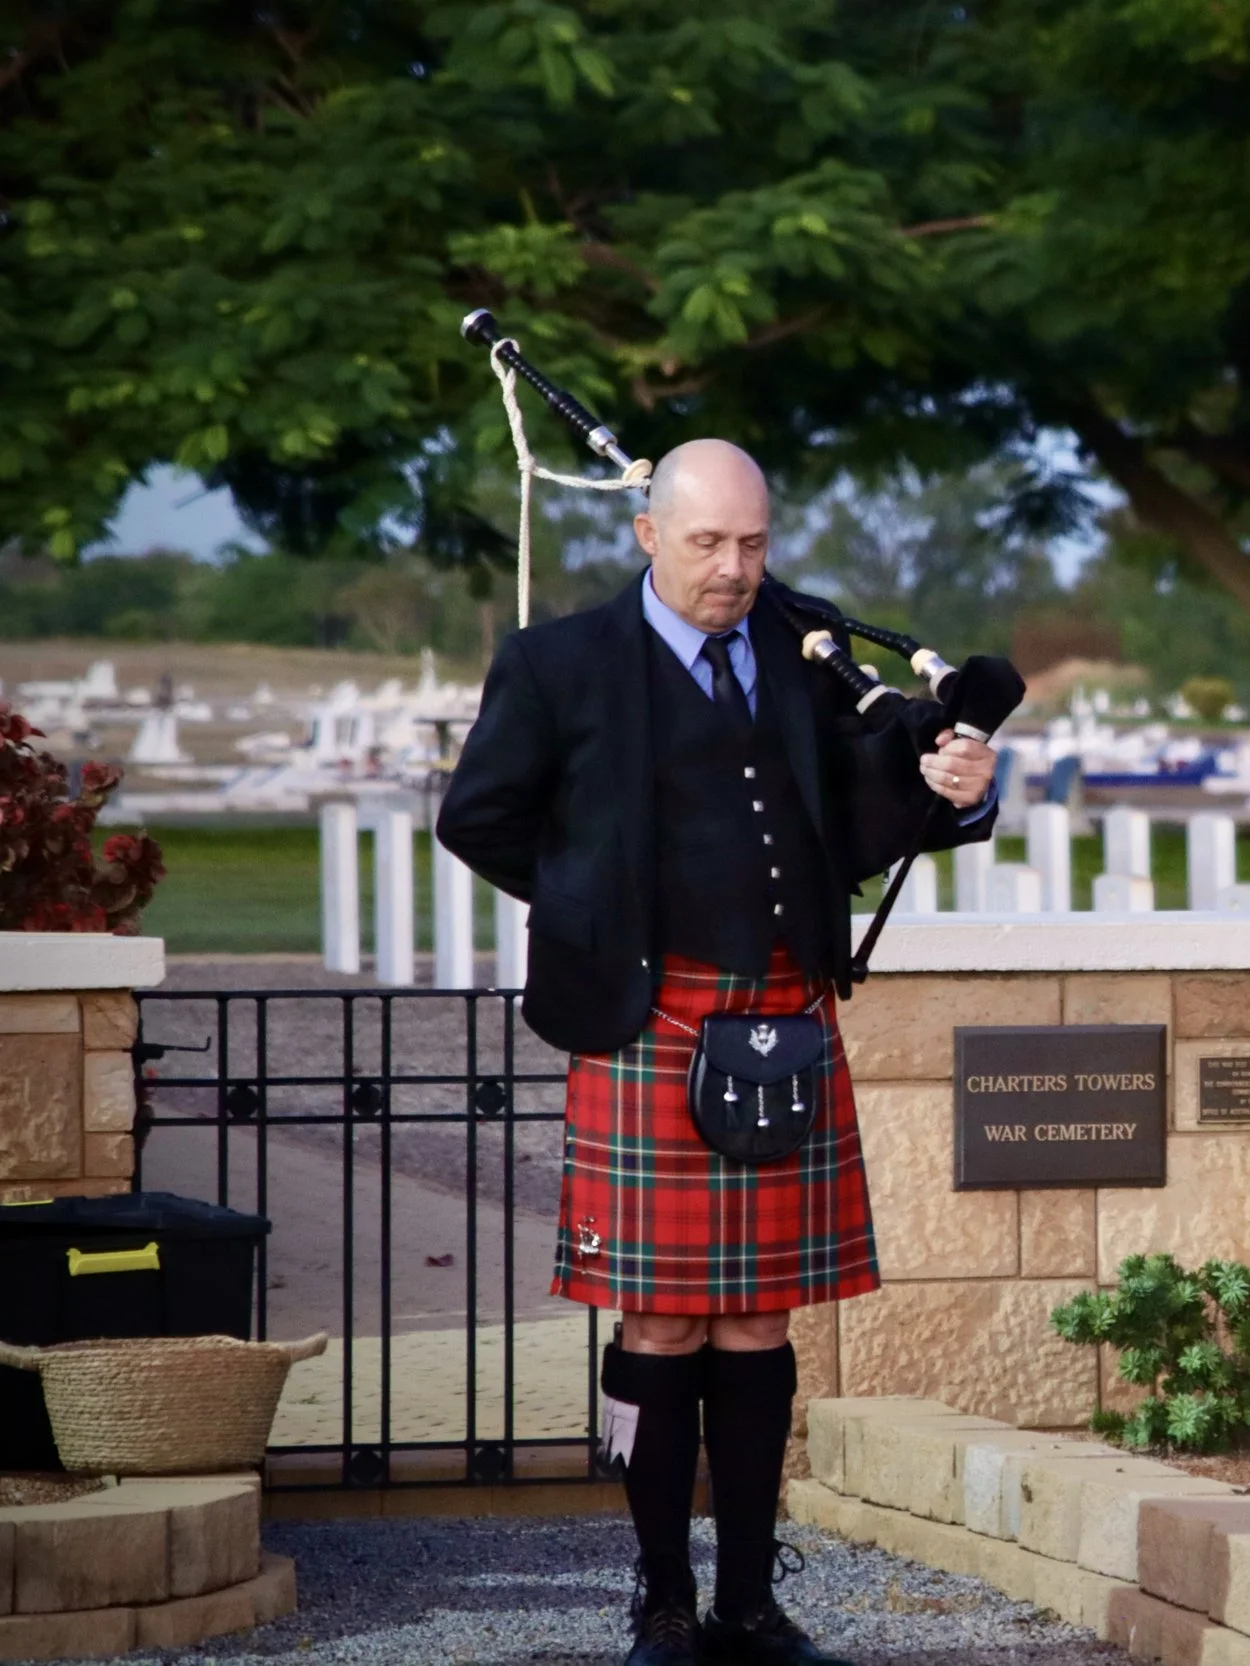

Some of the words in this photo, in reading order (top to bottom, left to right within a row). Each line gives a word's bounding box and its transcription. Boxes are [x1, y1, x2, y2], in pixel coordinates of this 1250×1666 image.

[966, 1075, 1068, 1093] CHARTERS
[1073, 1073, 1156, 1092] TOWERS
[984, 1125, 1028, 1142] WAR
[1034, 1123, 1137, 1141] CEMETERY
